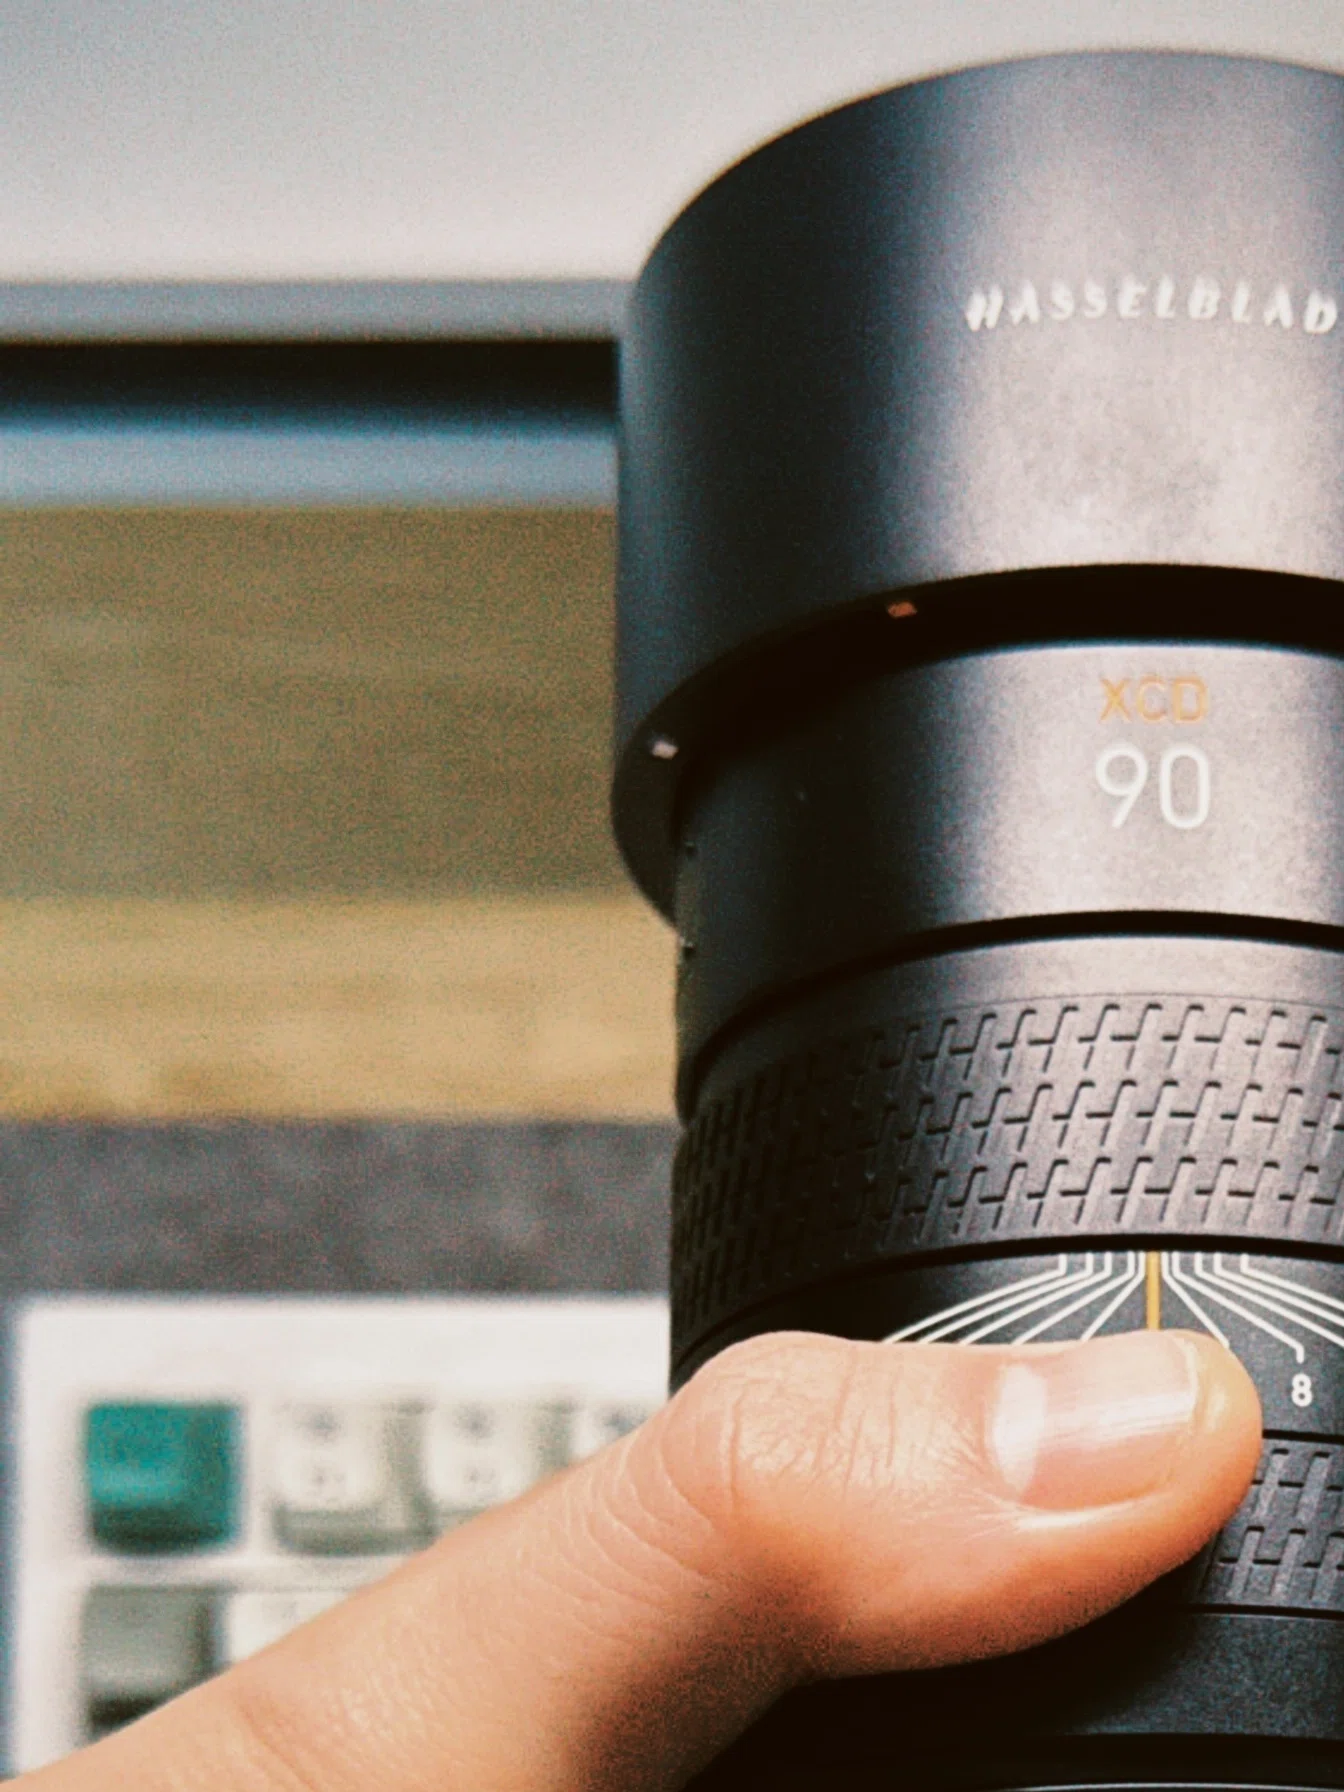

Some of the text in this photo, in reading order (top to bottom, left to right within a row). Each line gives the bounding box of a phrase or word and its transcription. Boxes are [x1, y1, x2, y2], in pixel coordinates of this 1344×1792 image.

[965, 275, 1338, 334] HASSELBLAD
[1099, 676, 1209, 722] XCD
[1095, 742, 1212, 831] 90
[1290, 1373, 1314, 1407] 8
